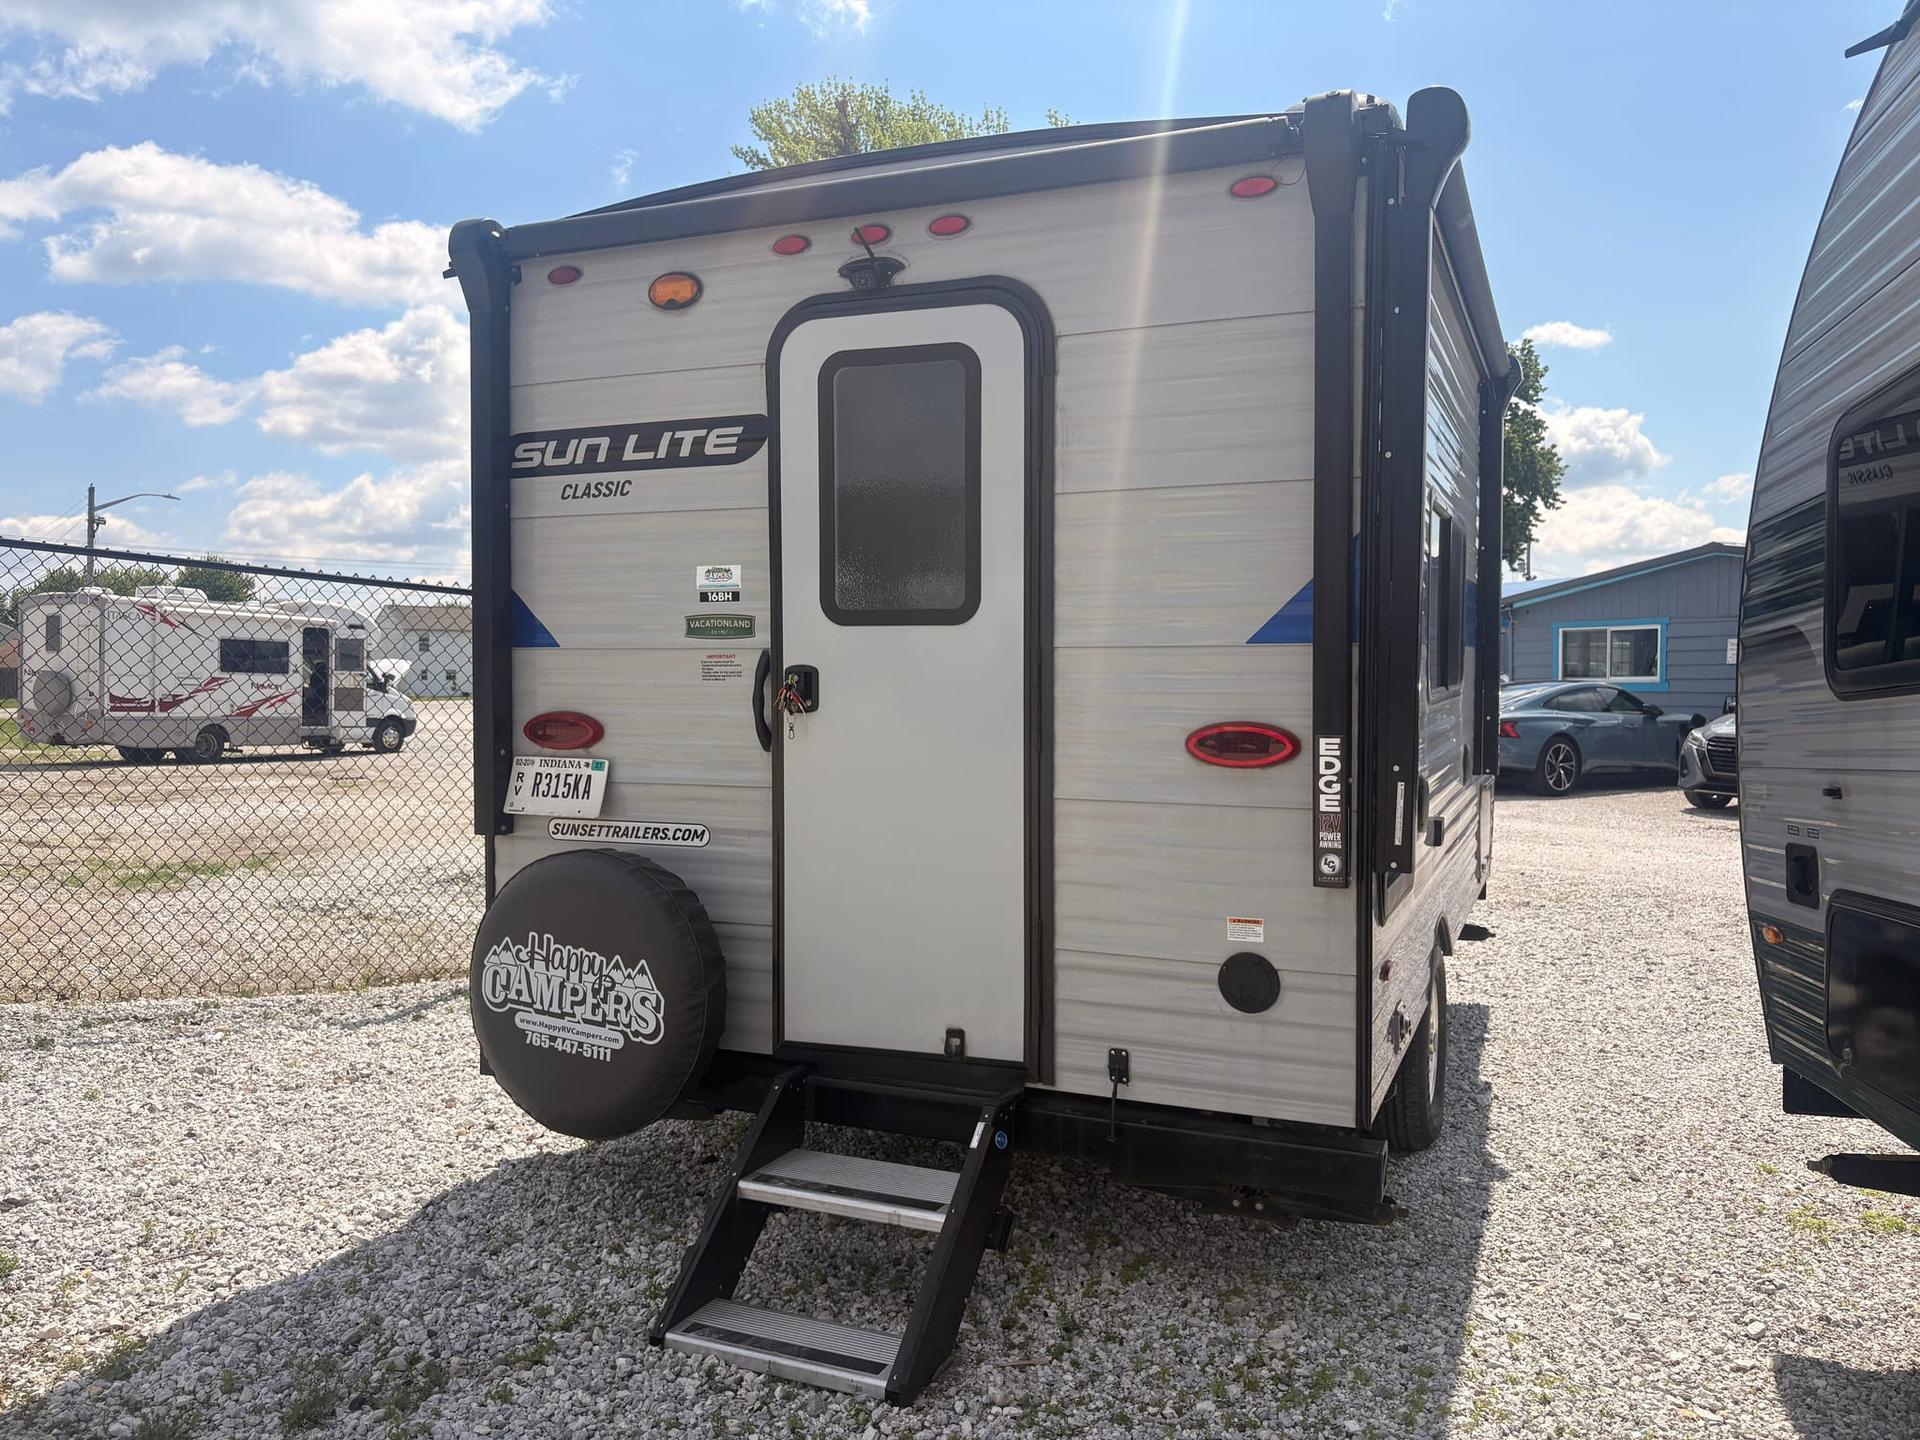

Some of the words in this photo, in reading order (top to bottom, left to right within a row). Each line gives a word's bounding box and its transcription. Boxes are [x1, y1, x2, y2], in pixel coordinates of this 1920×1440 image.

[511, 436, 611, 469] SUN
[622, 426, 745, 461] LITE
[560, 479, 633, 500] CLASSIC
[707, 592, 733, 602] 16BH
[689, 619, 751, 629] VACATIONLAND
[539, 758, 582, 769] INDIANA
[1318, 737, 1342, 812] EDGE
[531, 772, 592, 801] R315KA
[551, 822, 706, 843] SUNSETTRAILERS.COM
[1319, 813, 1342, 832] 12V
[1319, 832, 1342, 841] POWER
[1319, 841, 1342, 849] AWNING
[515, 932, 608, 980] Happy
[484, 963, 662, 1037] CAMPERS
[519, 1016, 620, 1045] www.HappyRVCampers.com
[525, 1030, 612, 1062] 765-447-5111
